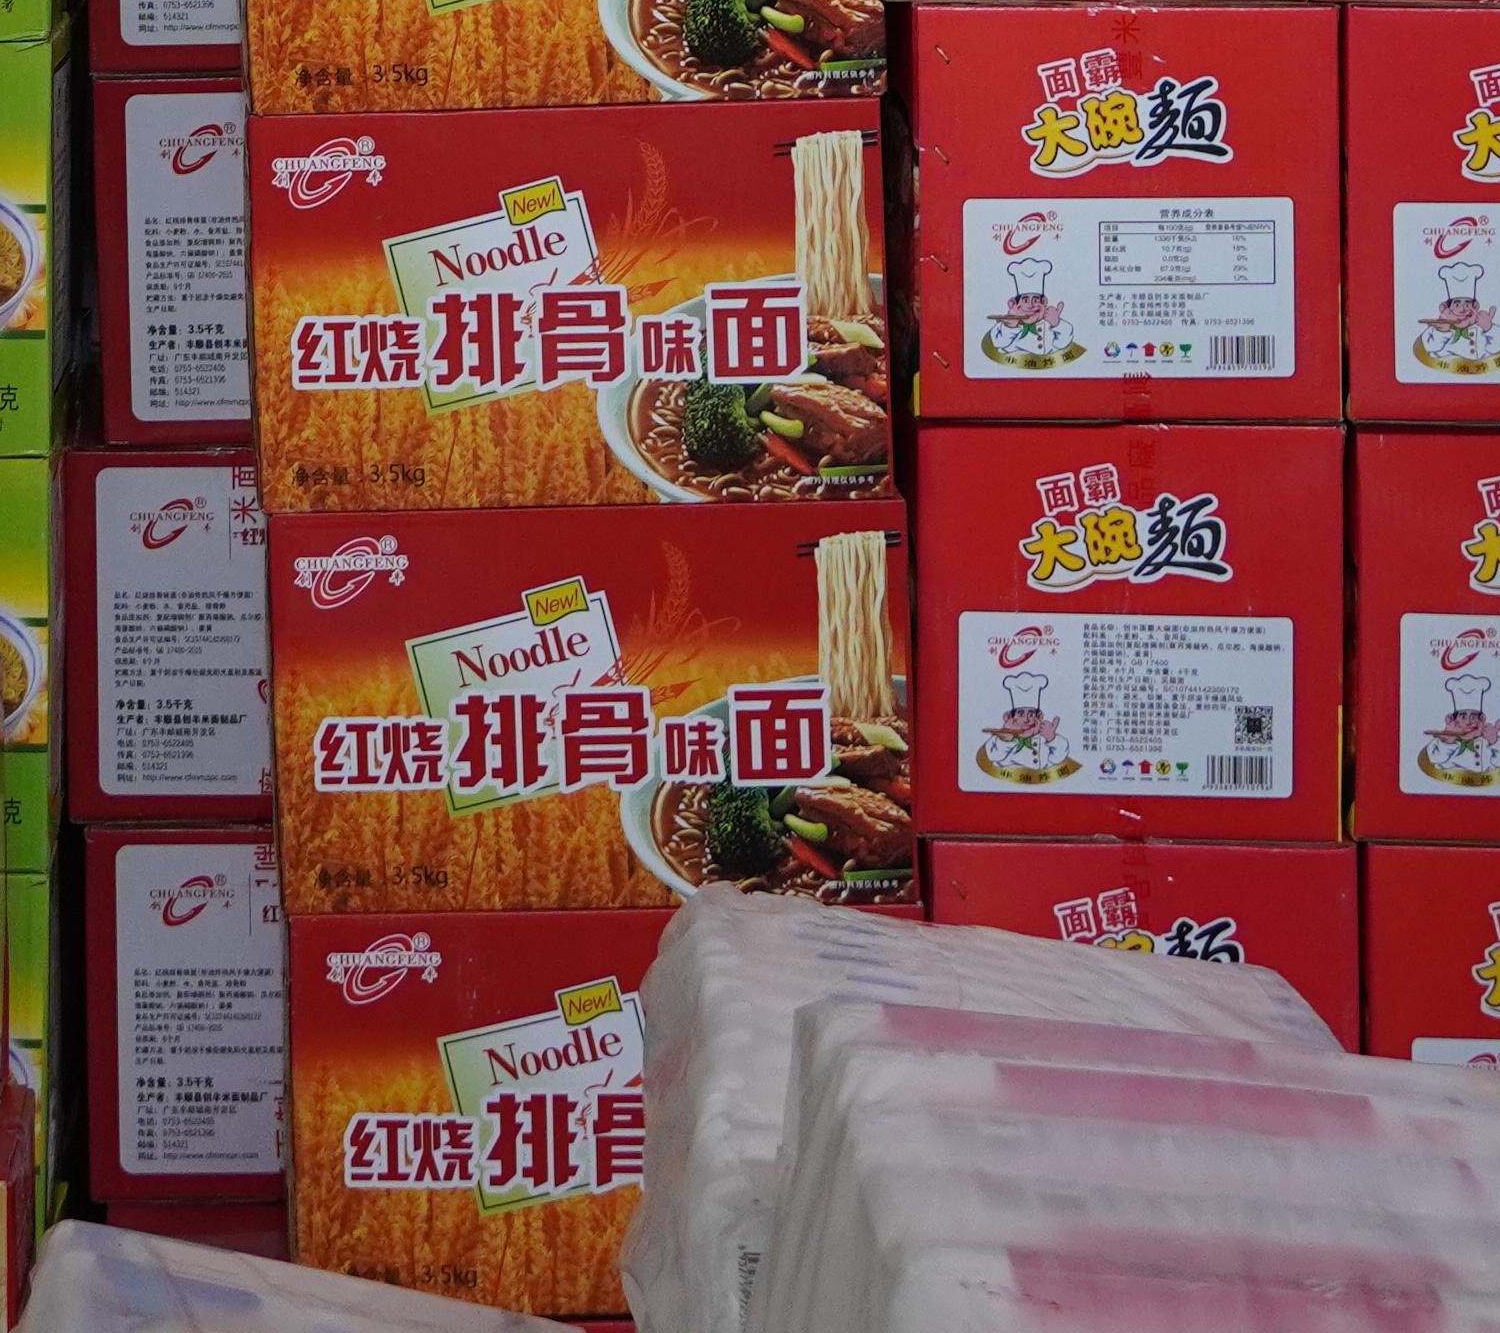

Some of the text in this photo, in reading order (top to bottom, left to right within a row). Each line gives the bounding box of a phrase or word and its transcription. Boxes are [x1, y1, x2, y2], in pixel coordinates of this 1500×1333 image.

[316, 684, 830, 790] 红烧排骨味面
[485, 1028, 625, 1086] Noodle
